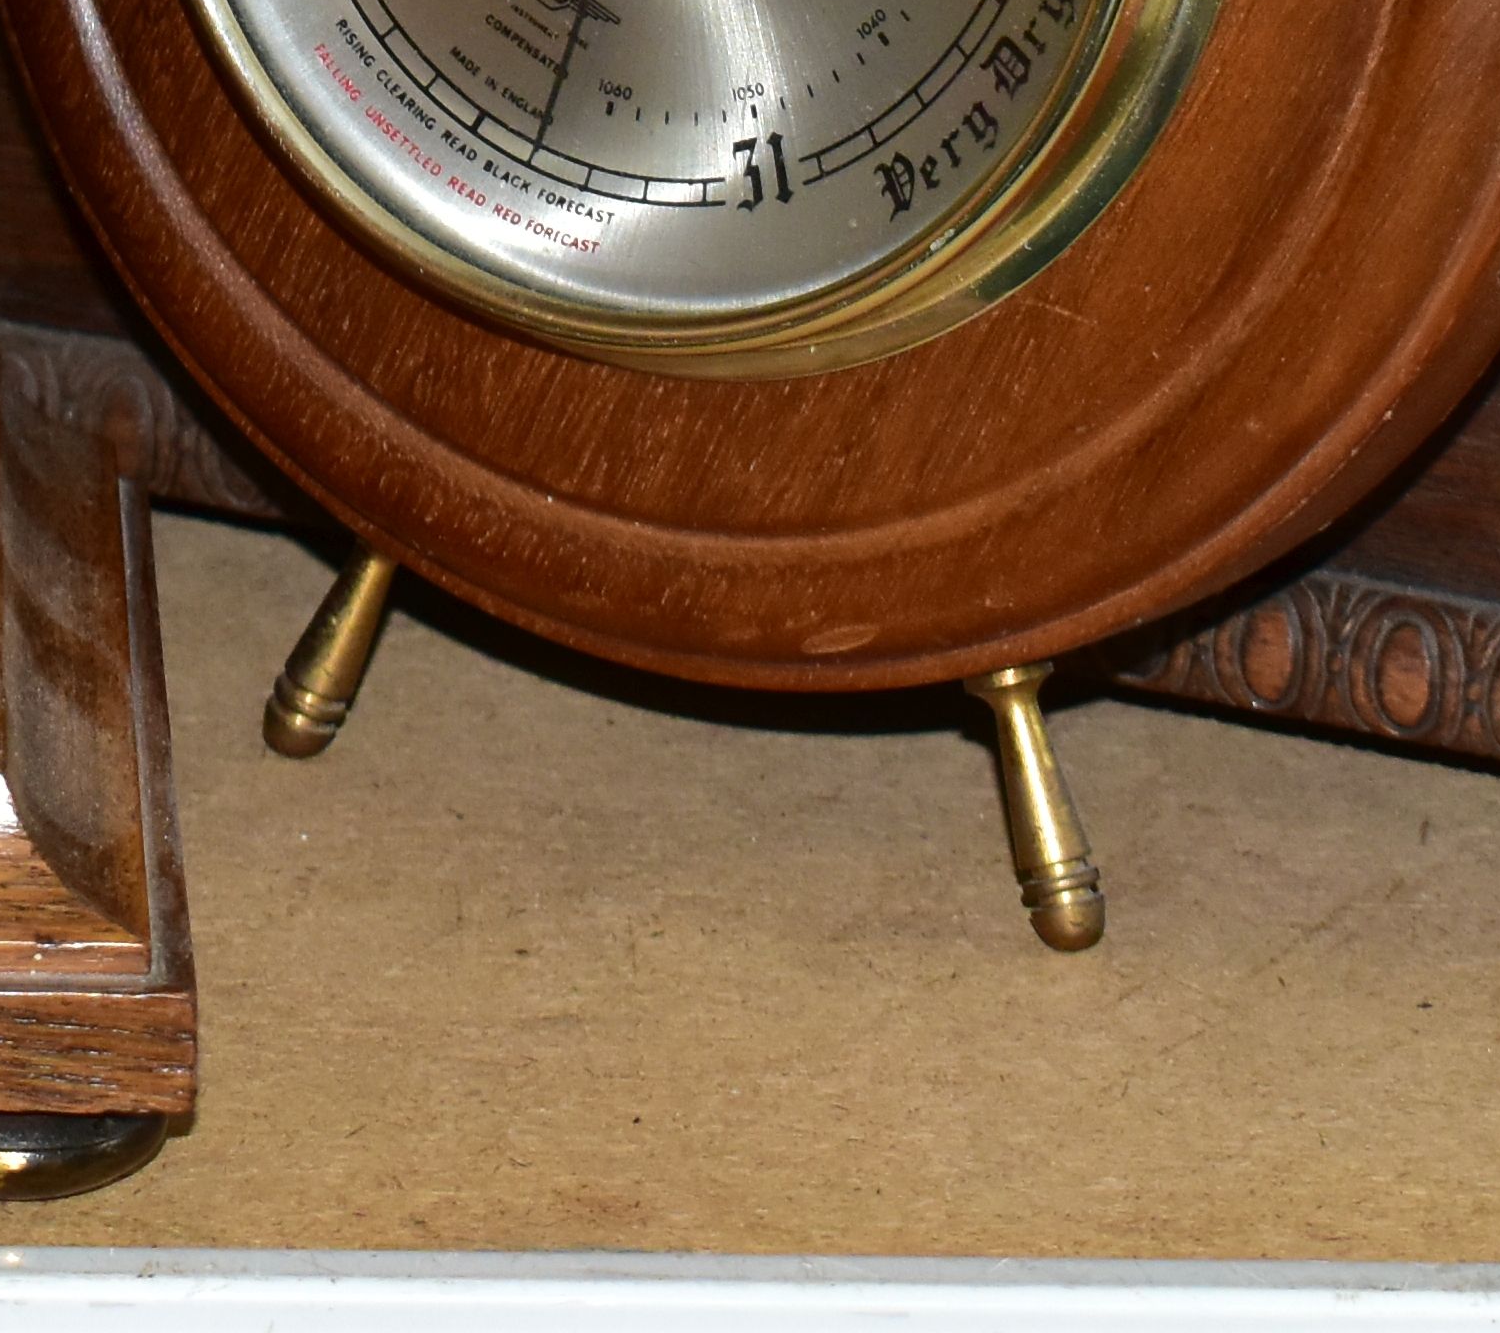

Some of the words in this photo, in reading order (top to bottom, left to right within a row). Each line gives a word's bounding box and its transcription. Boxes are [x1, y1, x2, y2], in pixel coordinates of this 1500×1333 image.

[856, 8, 887, 40] 1040
[450, 46, 481, 77] MADE
[485, 75, 497, 92] IN
[598, 78, 633, 101] 1060
[732, 82, 765, 102] 1050
[314, 43, 362, 103] FALLING
[364, 104, 442, 177] UNSETTLED
[447, 177, 487, 208] READ
[492, 203, 521, 225] RED
[336, 18, 375, 68] RISING
[376, 69, 438, 131] CLEARING
[441, 130, 477, 162] READ
[483, 159, 531, 195] BLACK
[537, 187, 615, 225] FORECAST
[732, 131, 794, 212] 31
[873, 100, 999, 224] Very
